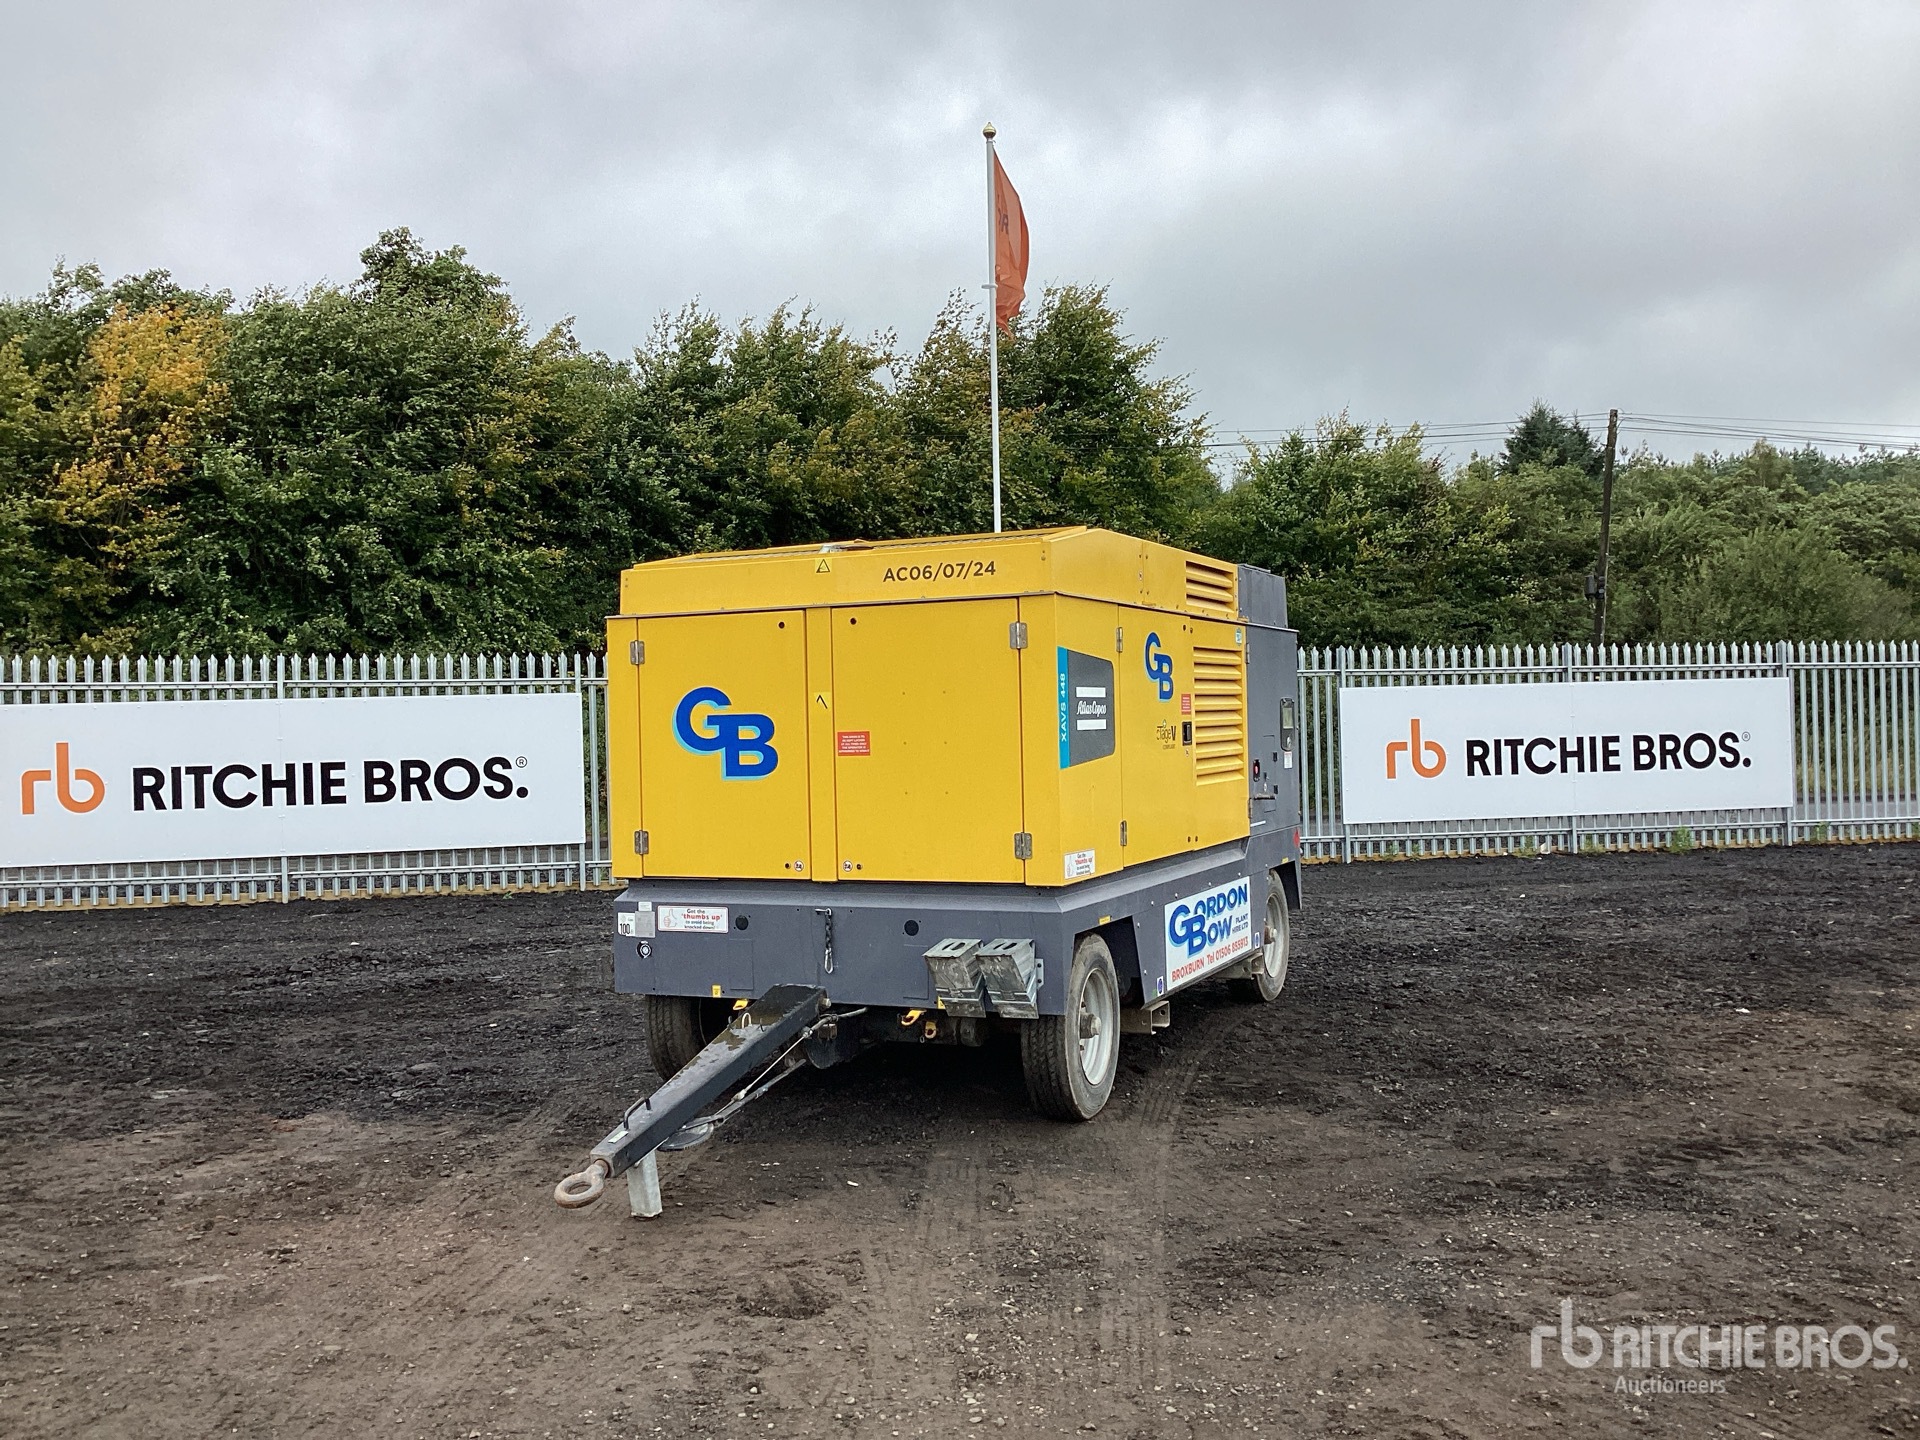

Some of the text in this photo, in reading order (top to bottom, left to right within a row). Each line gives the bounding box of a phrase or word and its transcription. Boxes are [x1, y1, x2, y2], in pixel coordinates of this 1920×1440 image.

[883, 560, 996, 583] AC06/07/24
[1143, 631, 1175, 703] GB
[672, 686, 779, 781] GB
[1060, 702, 1068, 741] XAVS
[1386, 718, 1447, 780] rb
[1466, 735, 1621, 777] RITCHIE
[21, 741, 105, 815] rb
[133, 761, 347, 812] RITCHIE
[619, 923, 630, 935] 100
[1169, 884, 1248, 947] GORDON
[1232, 921, 1249, 934] HIRE LTD
[1235, 913, 1249, 924] PLANT
[1185, 915, 1233, 958] BOW
[1171, 957, 1205, 982] BROXBURN
[1207, 953, 1215, 964] Tel
[1215, 945, 1231, 960] 01506
